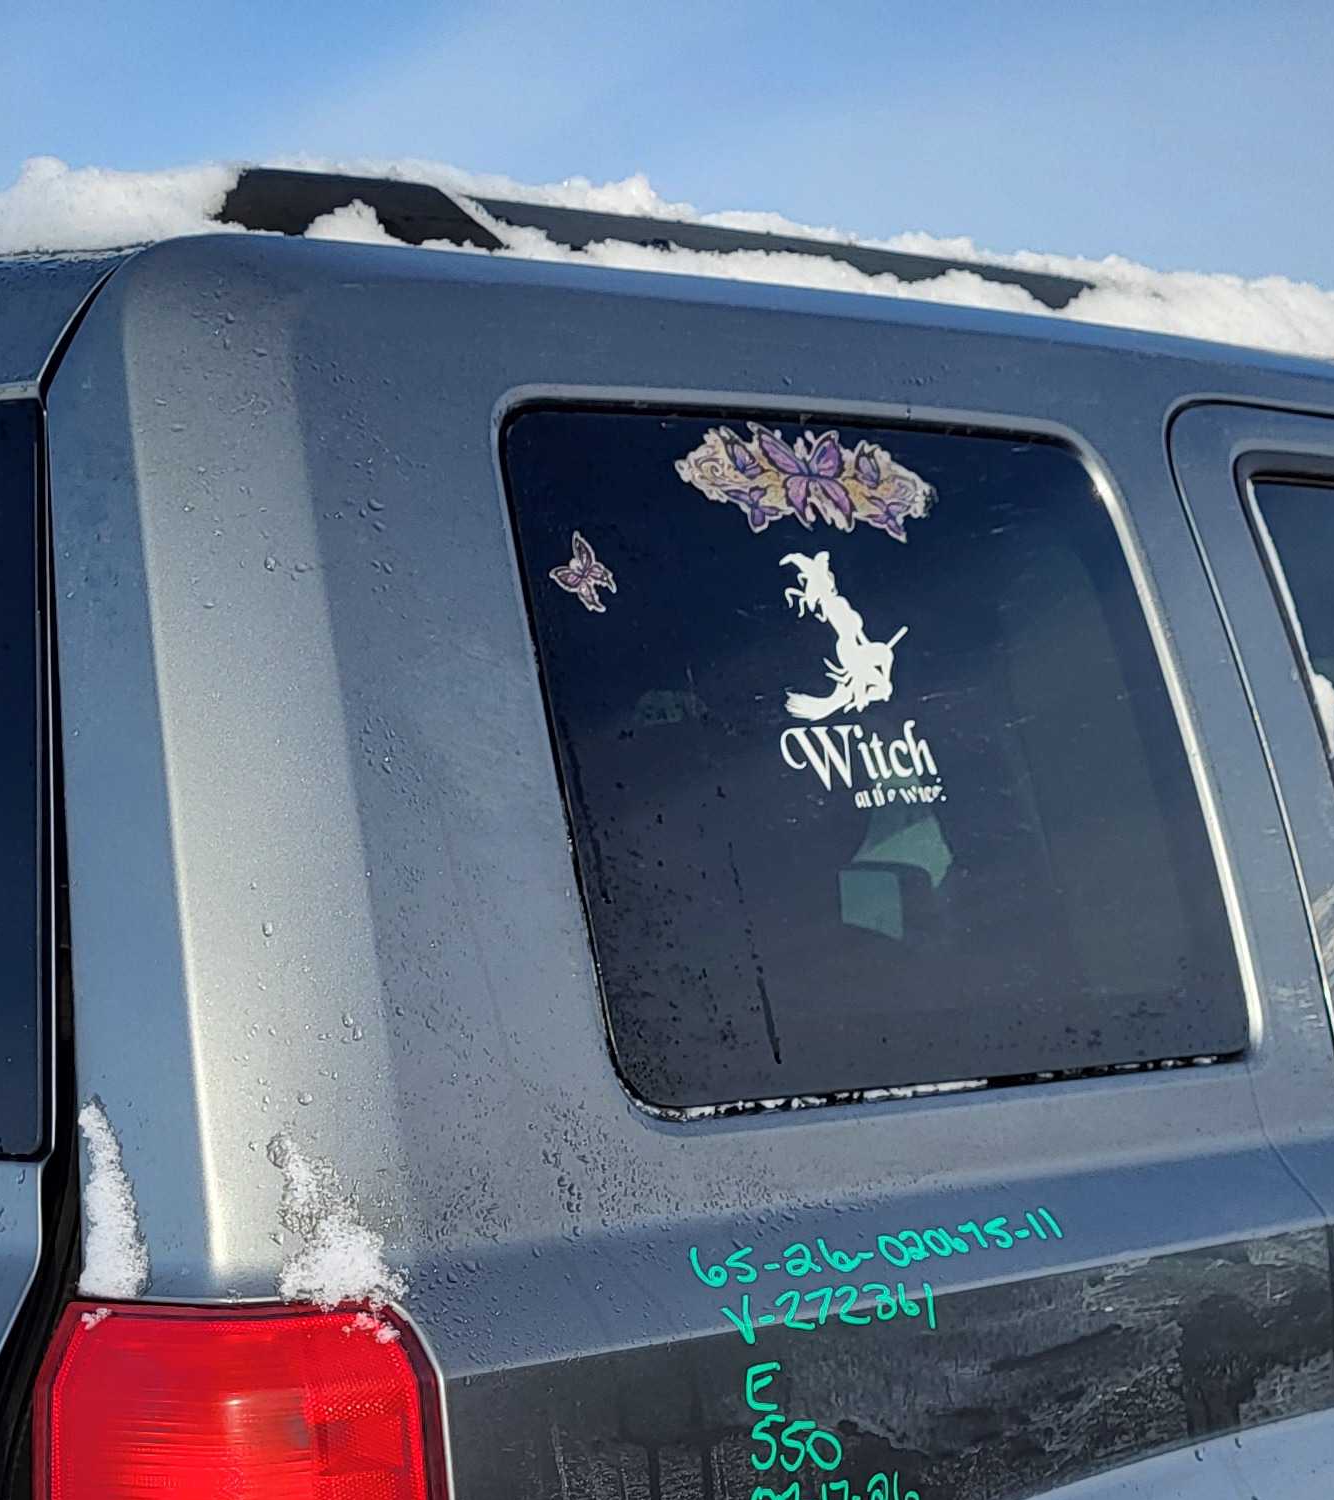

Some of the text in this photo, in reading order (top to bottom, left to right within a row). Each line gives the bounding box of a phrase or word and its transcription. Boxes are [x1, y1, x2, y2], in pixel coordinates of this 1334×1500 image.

[780, 719, 938, 791] Witch
[688, 1207, 1063, 1287] 65-26-020675-11
[745, 1362, 781, 1411] E
[749, 1414, 842, 1471] 550
